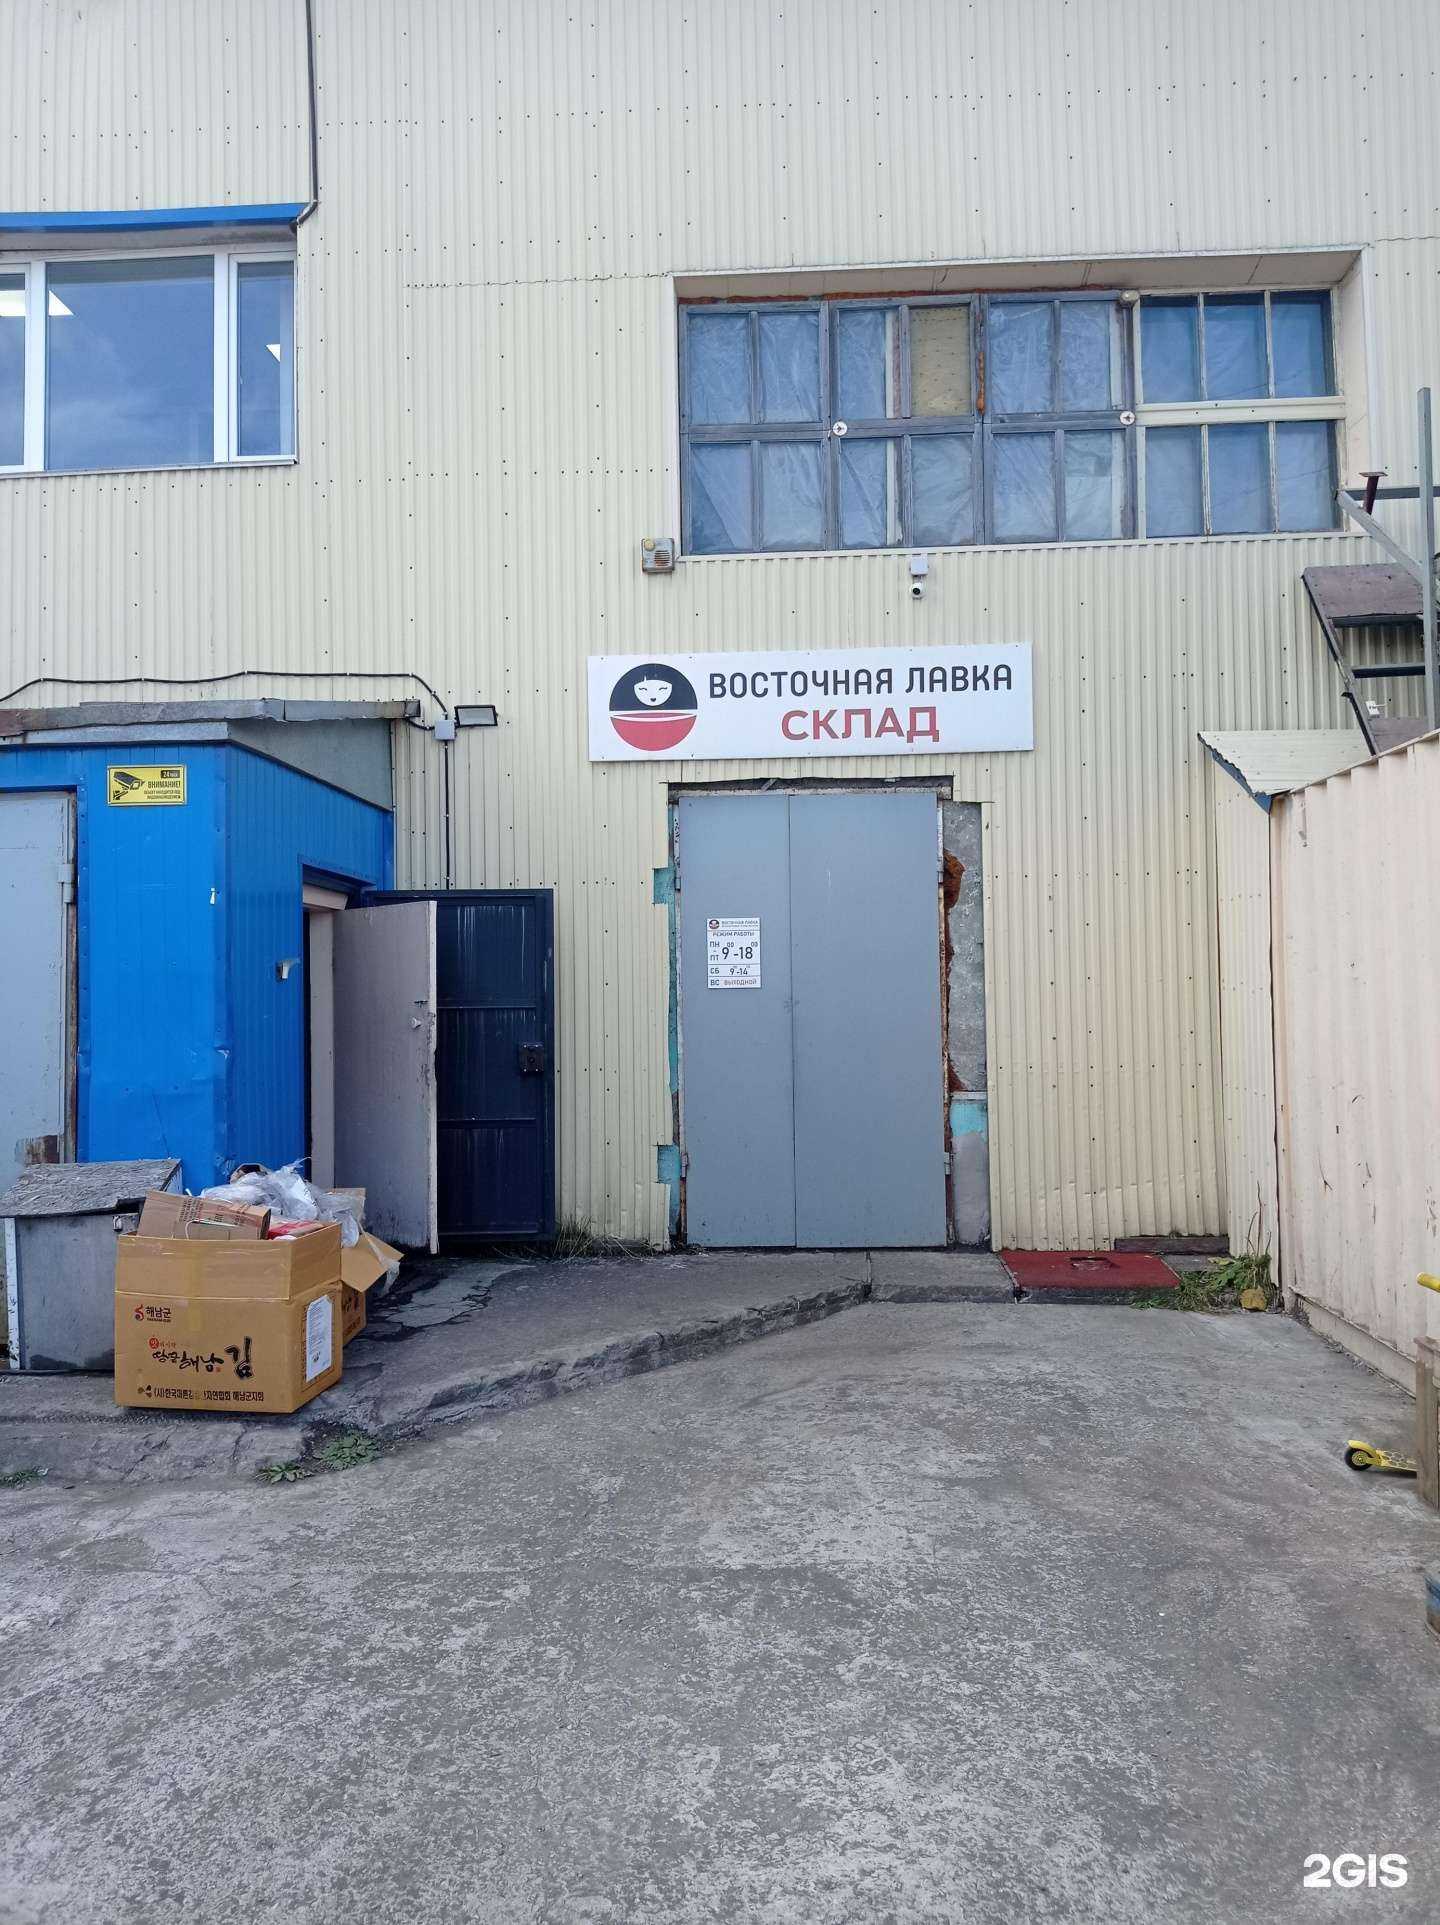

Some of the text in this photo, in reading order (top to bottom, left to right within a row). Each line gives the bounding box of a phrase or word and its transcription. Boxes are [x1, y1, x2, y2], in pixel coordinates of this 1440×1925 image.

[709, 664, 1012, 699] ВОСТОЧНАЯ ЛАВКА
[781, 706, 940, 744] СКЛАД
[145, 1306, 171, 1318] 해남군
[224, 1335, 254, 1379] 김
